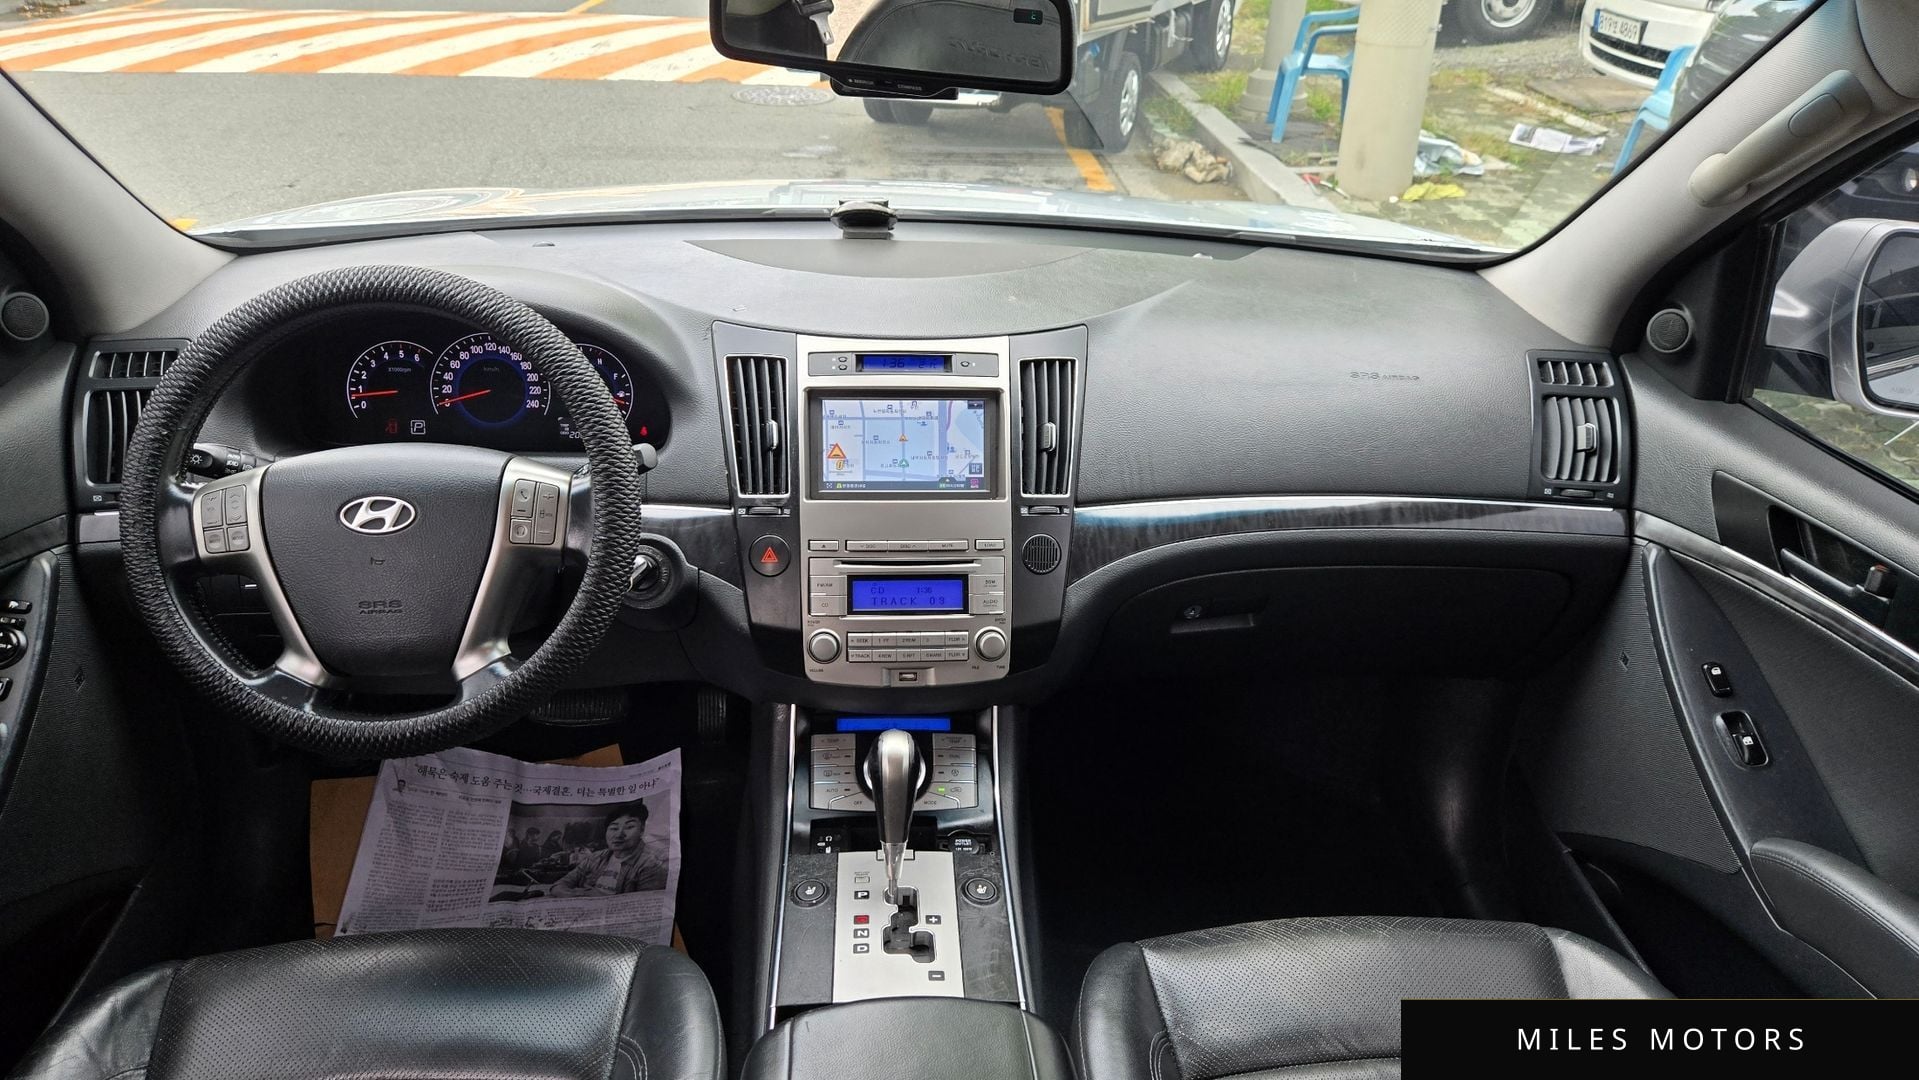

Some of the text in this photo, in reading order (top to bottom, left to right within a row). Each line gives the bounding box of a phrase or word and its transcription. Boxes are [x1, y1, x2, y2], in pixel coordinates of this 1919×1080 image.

[470, 345, 483, 354] 100
[484, 342, 497, 351] 120
[498, 345, 511, 354] 140
[383, 352, 389, 360] 4
[399, 350, 405, 358] 5
[414, 354, 420, 362] 6
[460, 351, 470, 360] 80
[510, 352, 523, 361] 160
[370, 360, 376, 368] 3
[450, 360, 460, 369] 60
[520, 361, 532, 370] 180
[361, 371, 367, 379] 2
[443, 372, 454, 381] 40
[527, 373, 539, 382] 200
[359, 385, 363, 393] 1
[442, 385, 452, 394] 20
[529, 386, 541, 395] 220
[361, 401, 367, 409] 0
[526, 401, 540, 410] 240
[870, 586, 885, 594] CD
[358, 600, 402, 609] SRS
[872, 597, 917, 605] TRACK
[470, 776, 490, 787] 도움
[493, 778, 513, 790] 주는
